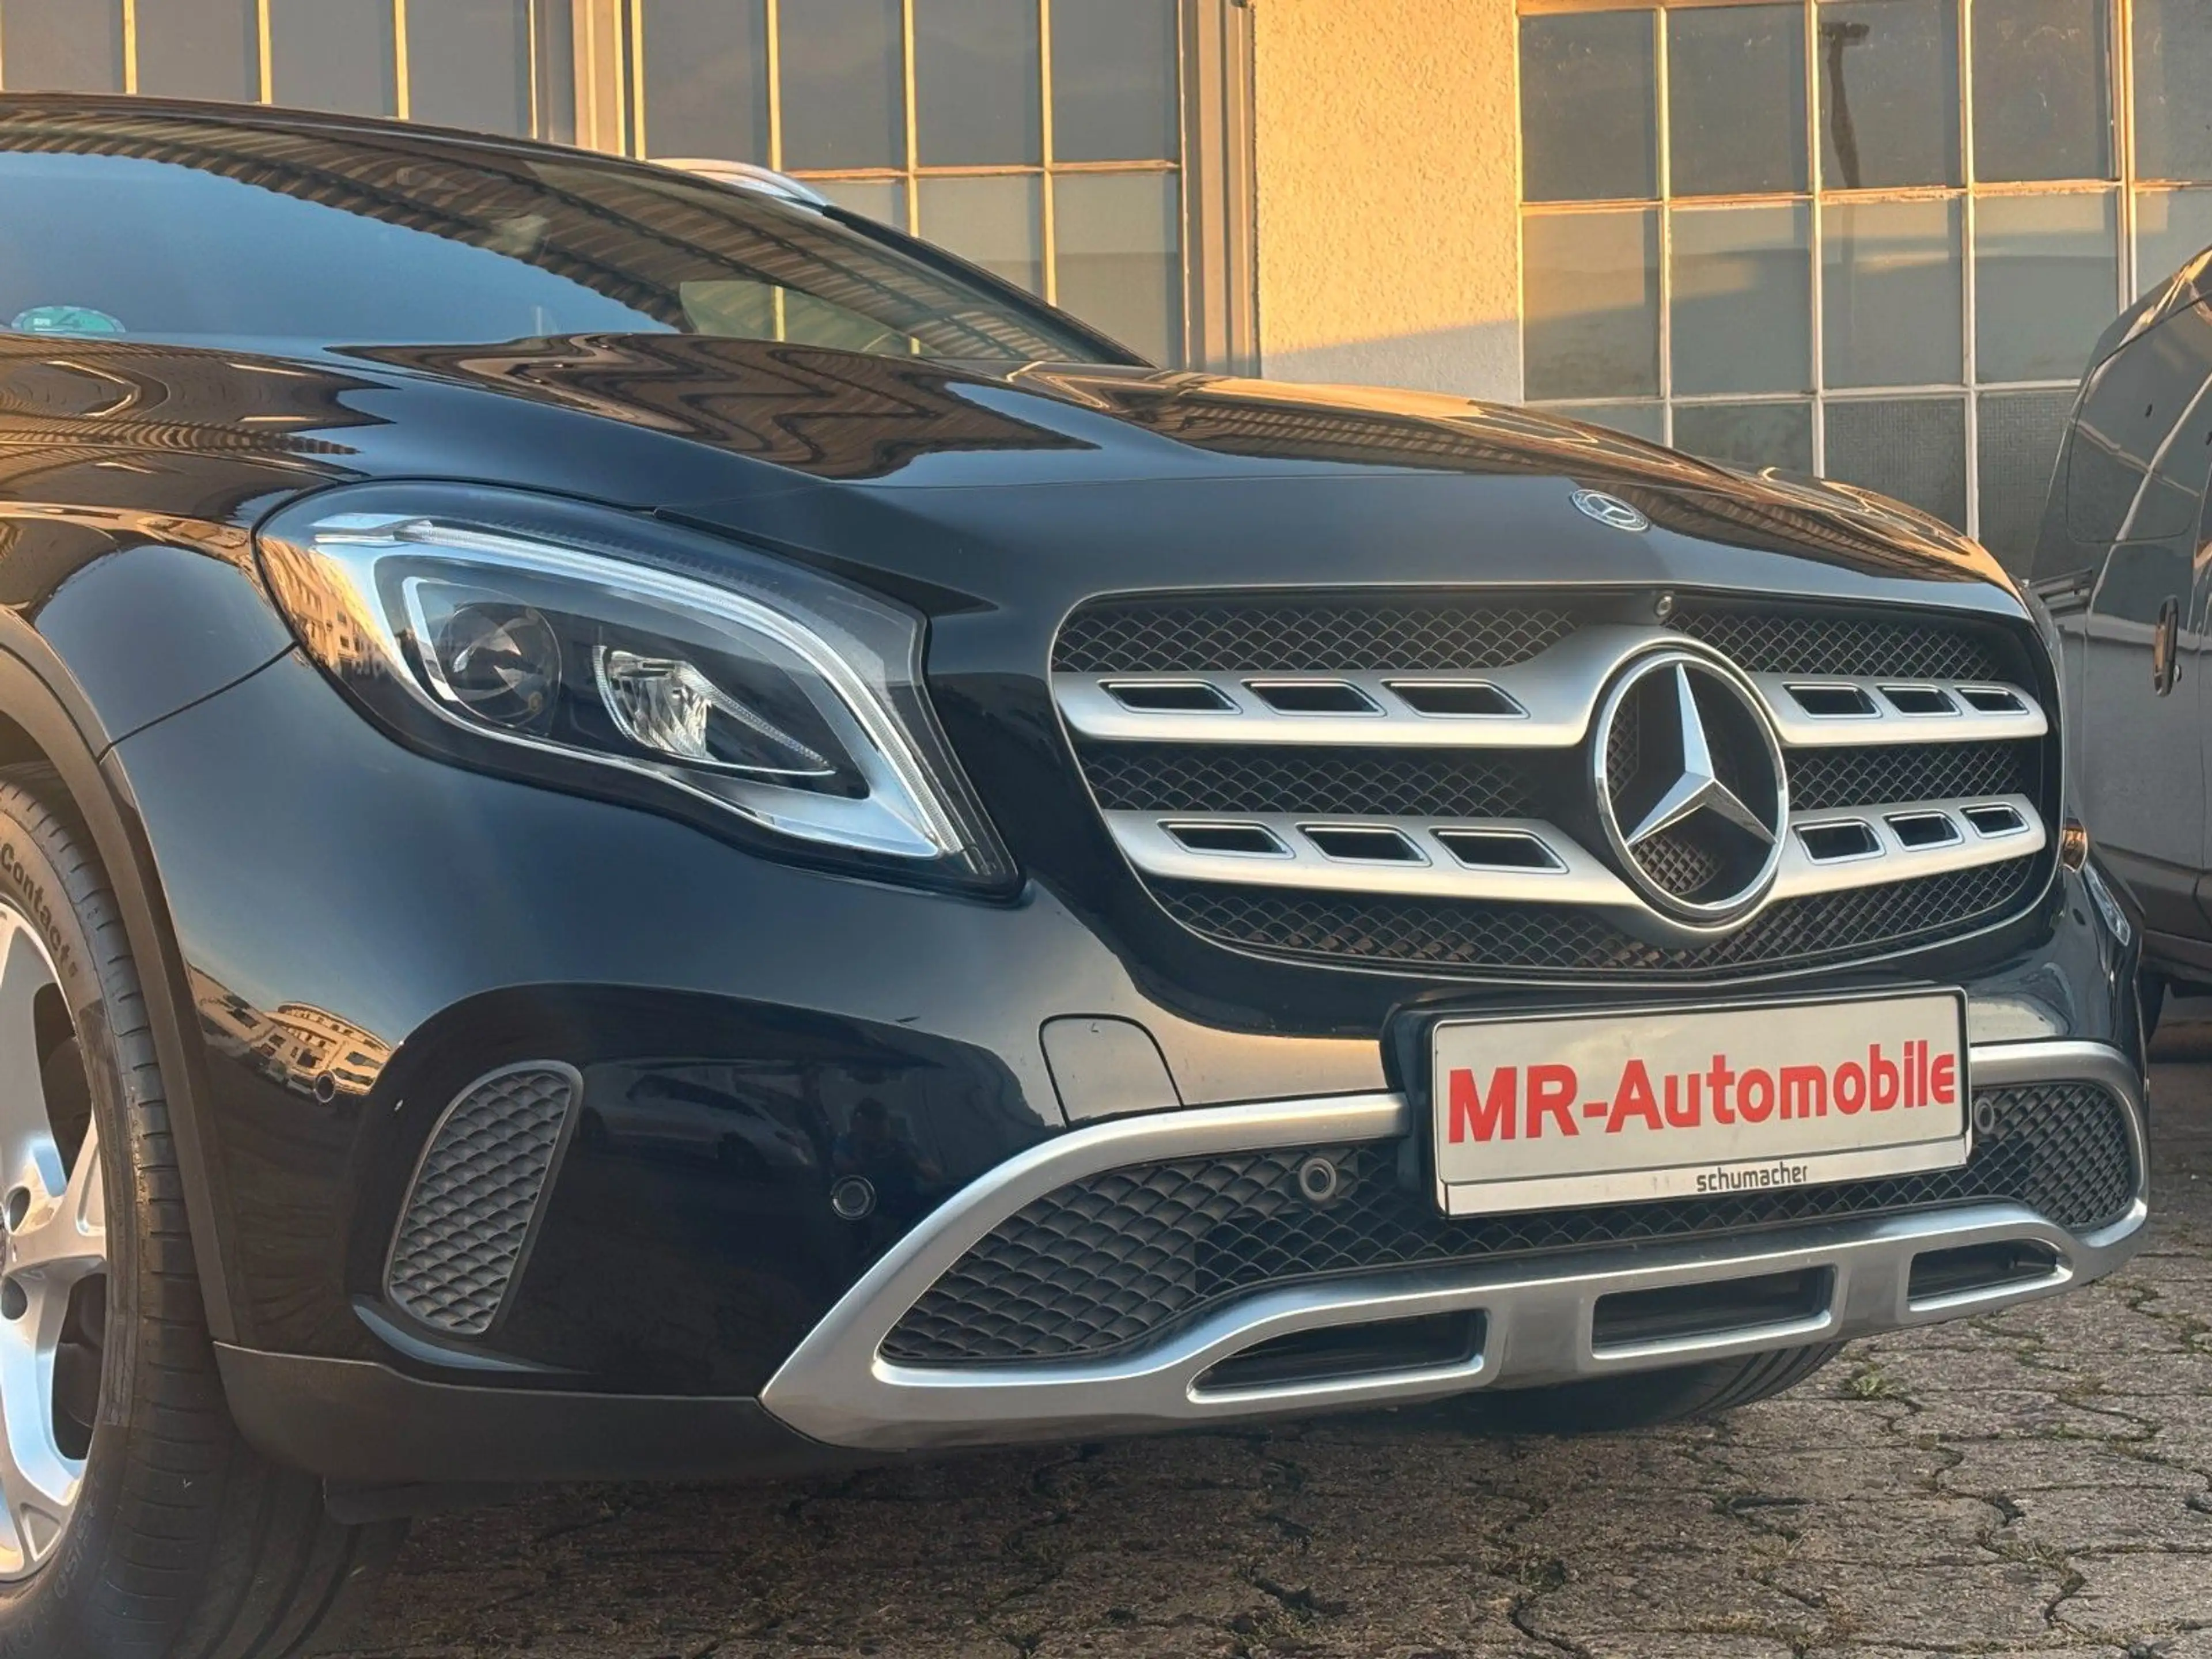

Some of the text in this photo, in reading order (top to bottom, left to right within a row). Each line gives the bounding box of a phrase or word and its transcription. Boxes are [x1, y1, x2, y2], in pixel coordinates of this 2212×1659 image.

[1, 843, 70, 969] Contact
[1449, 1040, 1955, 1143] MR-Automobile
[1696, 1161, 1808, 1192] schumacher
